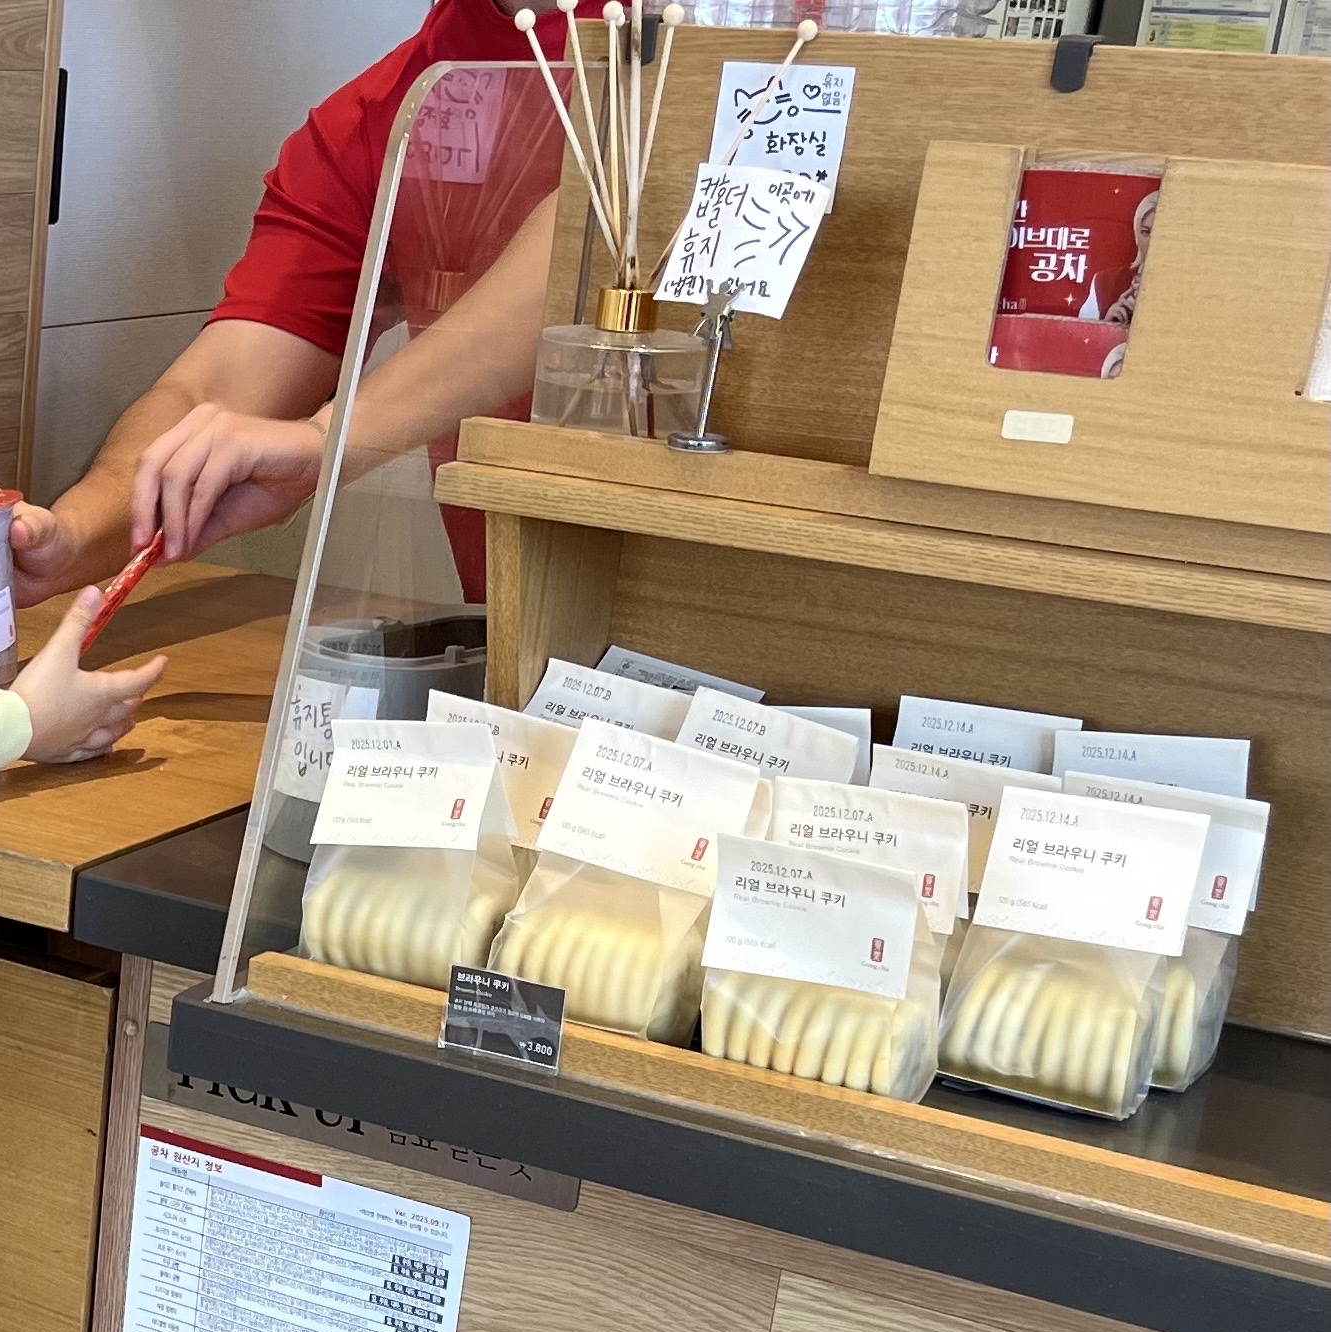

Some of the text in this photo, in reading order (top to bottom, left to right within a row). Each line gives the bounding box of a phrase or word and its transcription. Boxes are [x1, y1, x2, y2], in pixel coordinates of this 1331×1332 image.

[822, 72, 843, 89] 휴지
[765, 131, 827, 157] 화장실
[696, 173, 749, 228] 컵홀더
[769, 182, 815, 206] 이곳에
[680, 228, 721, 273] 휴지
[1029, 253, 1088, 283] 공차
[291, 684, 332, 740] 휴지통
[545, 701, 566, 715] 리얼
[922, 716, 974, 735] 2025.12.14.A
[508, 753, 530, 769] 쿠키
[596, 744, 652, 772] 2025.12.07.A
[695, 733, 790, 772] 리얼 브라우니 쿠키
[988, 753, 1012, 768] 쿠키
[1082, 746, 1137, 761] 2025.12.14.A
[347, 766, 438, 779] 리얼 브라우니 쿠키
[582, 767, 683, 807] 리얼 브라우니 쿠키
[813, 805, 873, 822] 2025.12.07.A
[968, 803, 993, 819] 쿠키
[790, 824, 897, 847] 리얼 브라우니 쿠키
[1013, 838, 1127, 868] 리얼 브라우니 쿠키
[750, 860, 813, 880] 2025.12.07.A
[735, 876, 846, 908] 리얼 브라우니 쿠키
[457, 972, 510, 992] 브라우니 쿠키
[151, 1145, 223, 1174] 공차 원산지 정보
